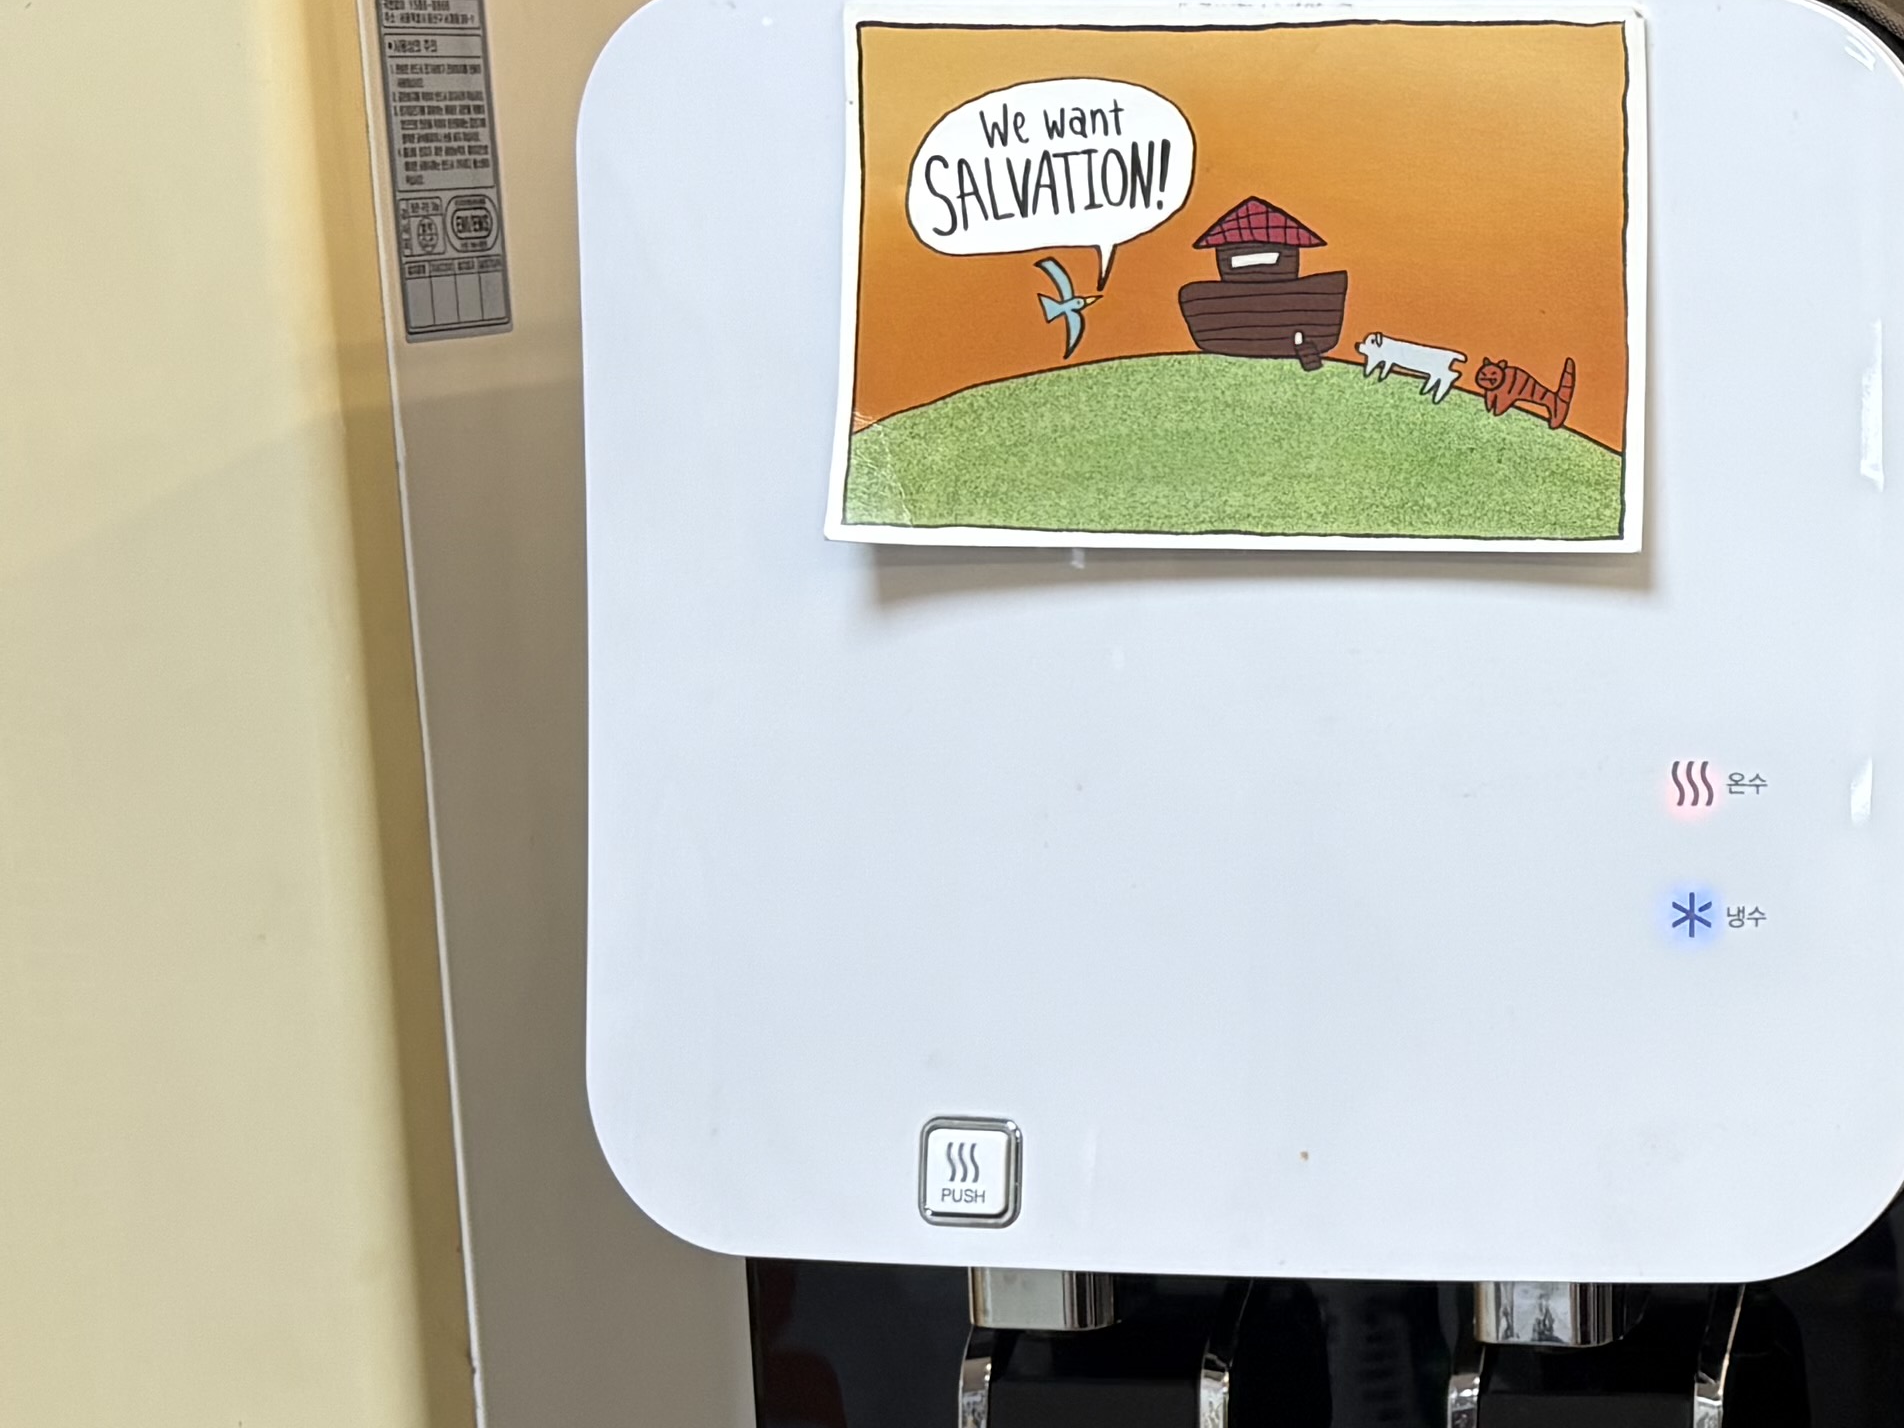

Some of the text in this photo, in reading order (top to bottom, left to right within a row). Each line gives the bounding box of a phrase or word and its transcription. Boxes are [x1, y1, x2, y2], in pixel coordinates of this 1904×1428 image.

[979, 99, 1124, 149] We want
[925, 139, 1171, 236] SALVATION!
[1726, 772, 1768, 795] 온수
[1726, 905, 1767, 928] 냉수
[941, 1188, 986, 1204] PUSH
